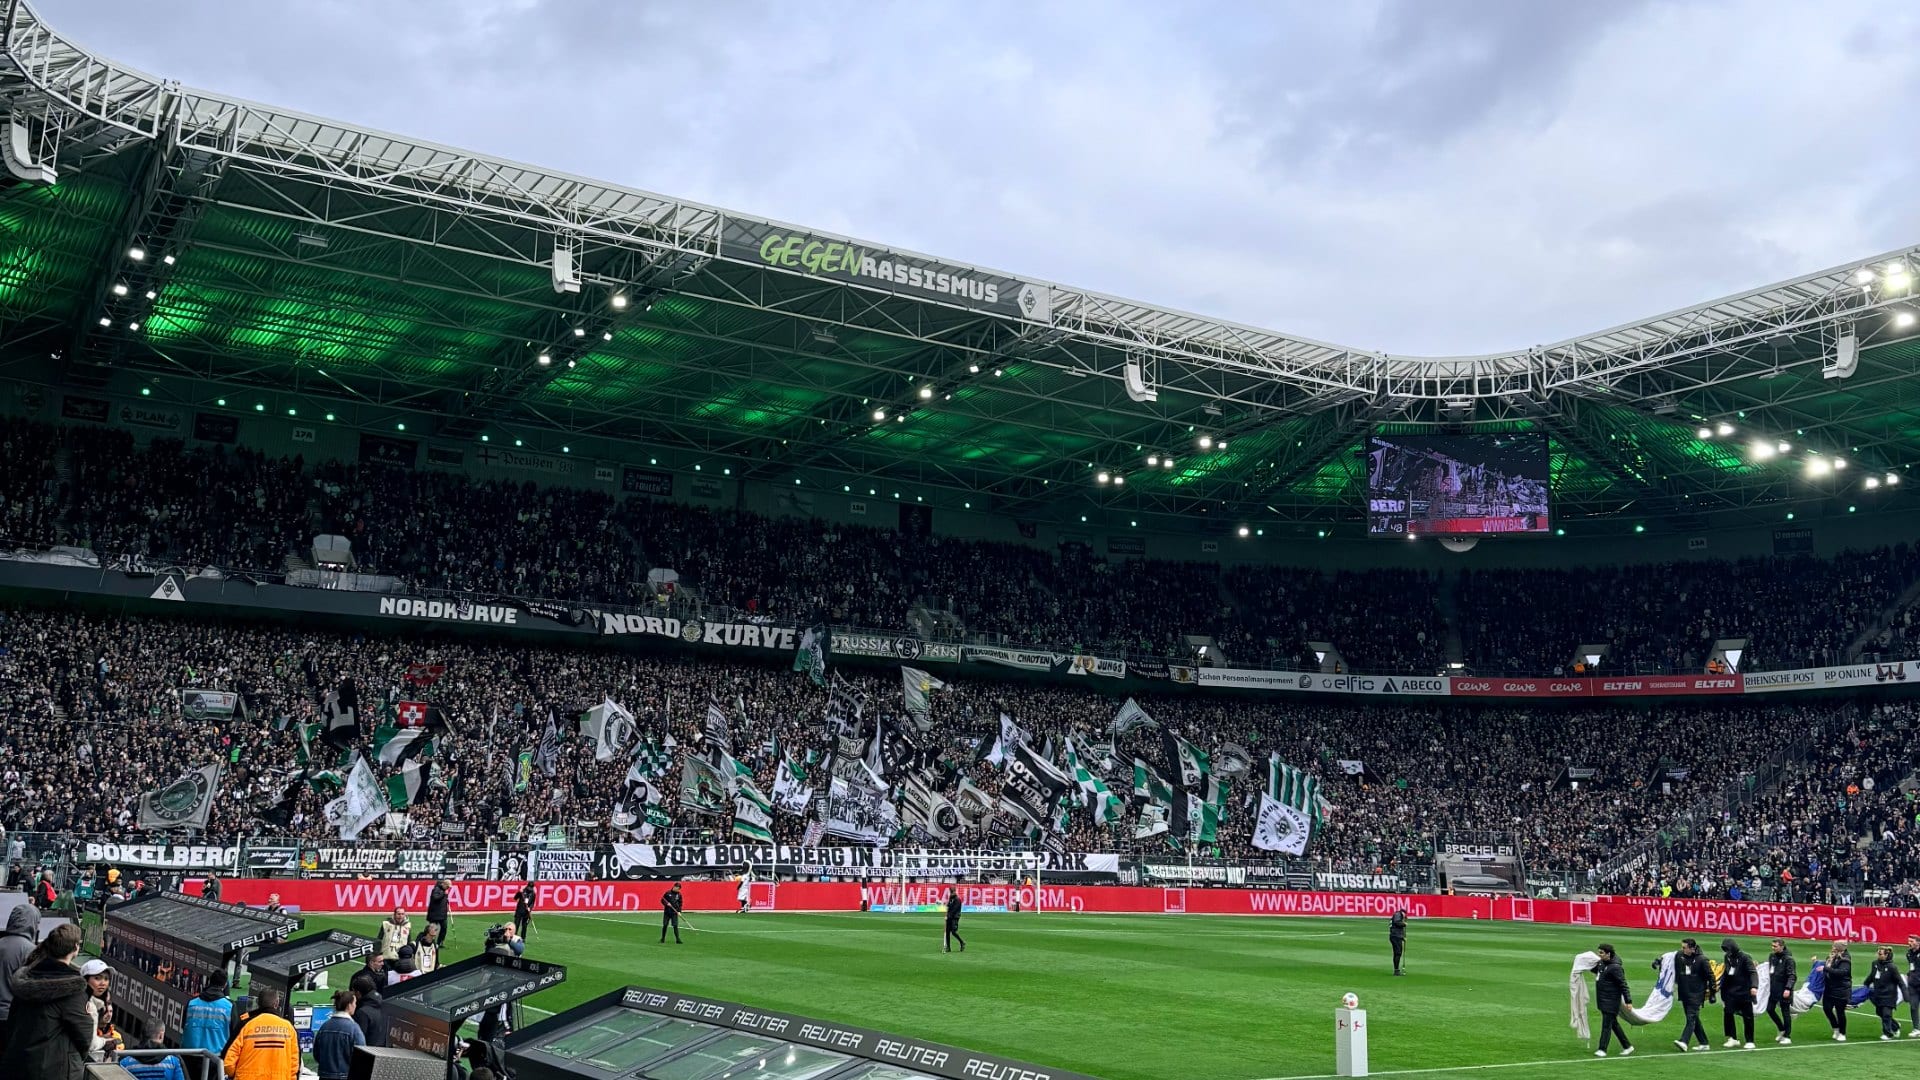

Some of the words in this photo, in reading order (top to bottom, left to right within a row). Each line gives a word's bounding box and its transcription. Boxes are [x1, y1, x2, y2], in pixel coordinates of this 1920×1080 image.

[759, 235, 866, 276] GEGEN
[861, 256, 998, 303] RASSISMUS
[380, 597, 517, 624] NORDKURVE
[604, 612, 681, 639] NORD
[703, 622, 797, 650] KURVE
[1098, 660, 1122, 672] JUNGS
[1745, 674, 1791, 687] RHEINISCHE
[1793, 672, 1815, 684] POST
[1825, 671, 1836, 681] RP
[1838, 668, 1872, 679] ONLINE
[1402, 680, 1442, 691] ABECO
[1457, 681, 1491, 693] cewe
[1503, 681, 1537, 693] cewe
[1550, 681, 1583, 692] cewe
[1603, 682, 1642, 691] ELTEN
[1694, 679, 1735, 689] ELTEN
[319, 848, 397, 863] WILLICHER
[539, 852, 592, 861] BORUSSIA
[653, 845, 707, 866] VOM
[850, 847, 873, 867] IN
[880, 847, 920, 868] DEN
[927, 848, 1089, 870] BORUSSIA-PARK
[1445, 844, 1513, 856] BRACHELEN
[795, 866, 824, 875] UNSER
[825, 867, 864, 876] ZUHAUS
[866, 867, 890, 877] OHNE
[1247, 866, 1285, 877] PUMUCKL
[1316, 872, 1398, 890] VITUSSTADT
[231, 922, 299, 950] REUTER
[298, 944, 374, 973] REUTER
[128, 978, 165, 1021] REUTER
[455, 1006, 471, 1016] AOK
[483, 996, 500, 1006] AOK
[511, 986, 527, 996] AOK
[539, 976, 555, 986] AOK
[624, 989, 668, 1008] REUTER
[674, 999, 724, 1019] REUTER
[734, 1010, 790, 1033] REUTER
[800, 1024, 863, 1049] REUTER
[874, 1039, 949, 1069] REUTER
